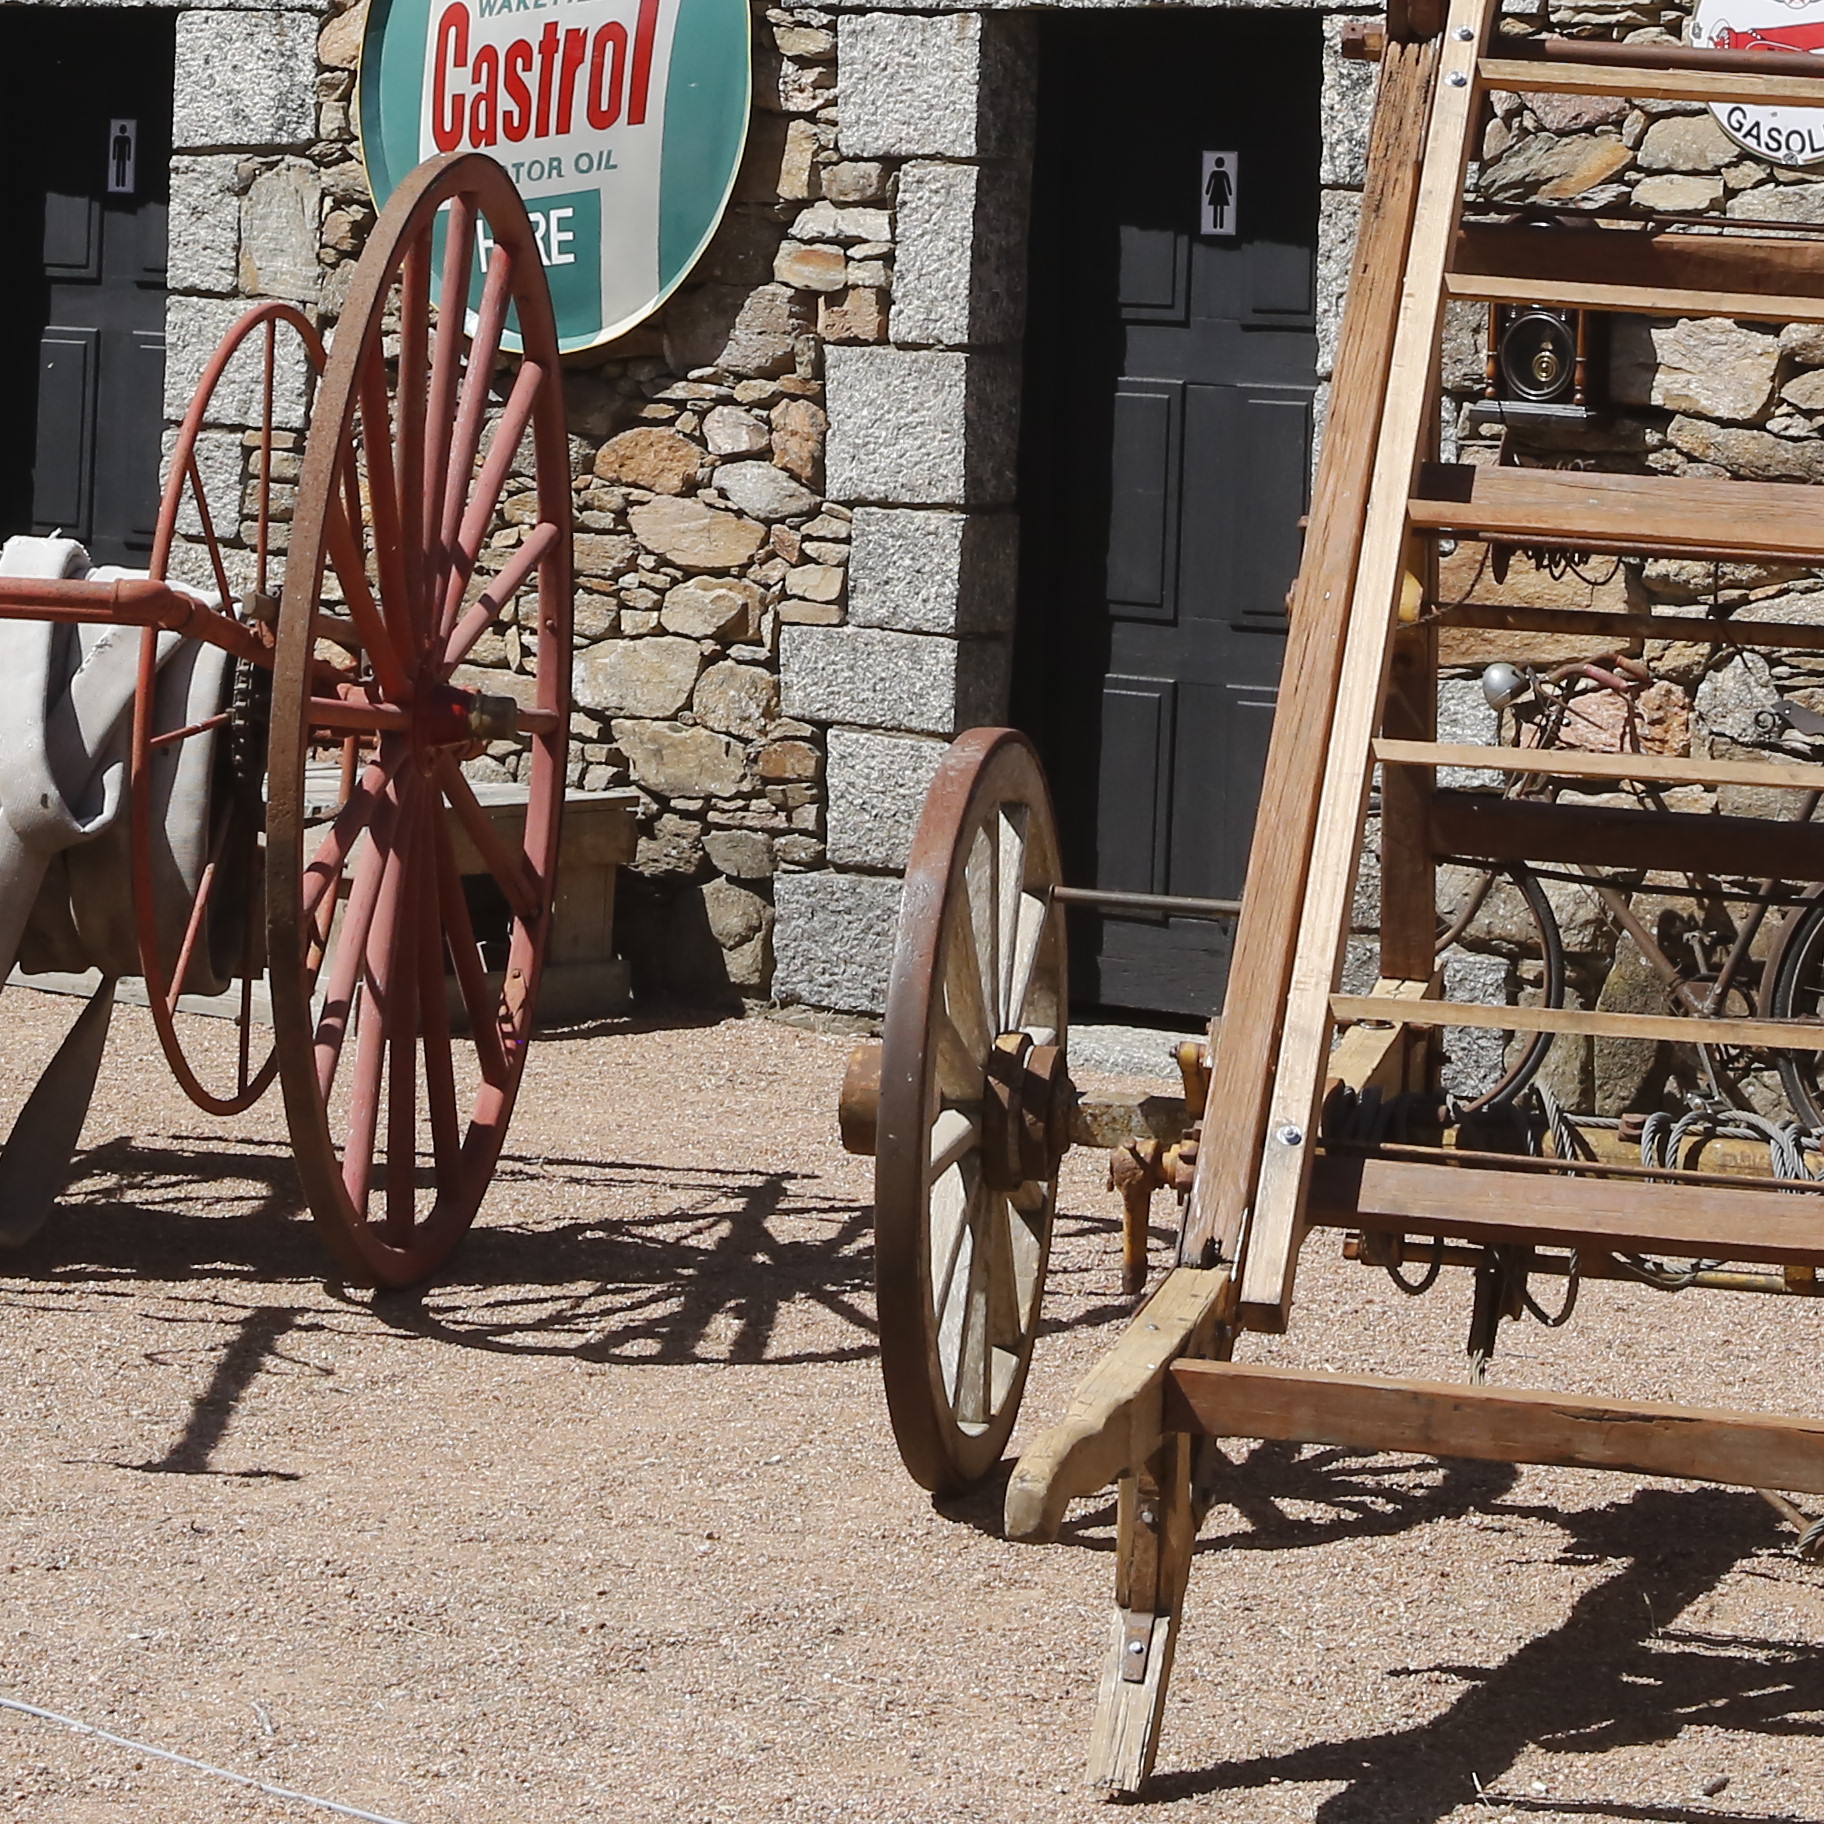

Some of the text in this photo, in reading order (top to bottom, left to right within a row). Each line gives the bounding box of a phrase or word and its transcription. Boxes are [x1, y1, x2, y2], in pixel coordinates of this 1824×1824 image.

[502, 149, 618, 184] TOR OIL
[476, 207, 575, 273] HRE
